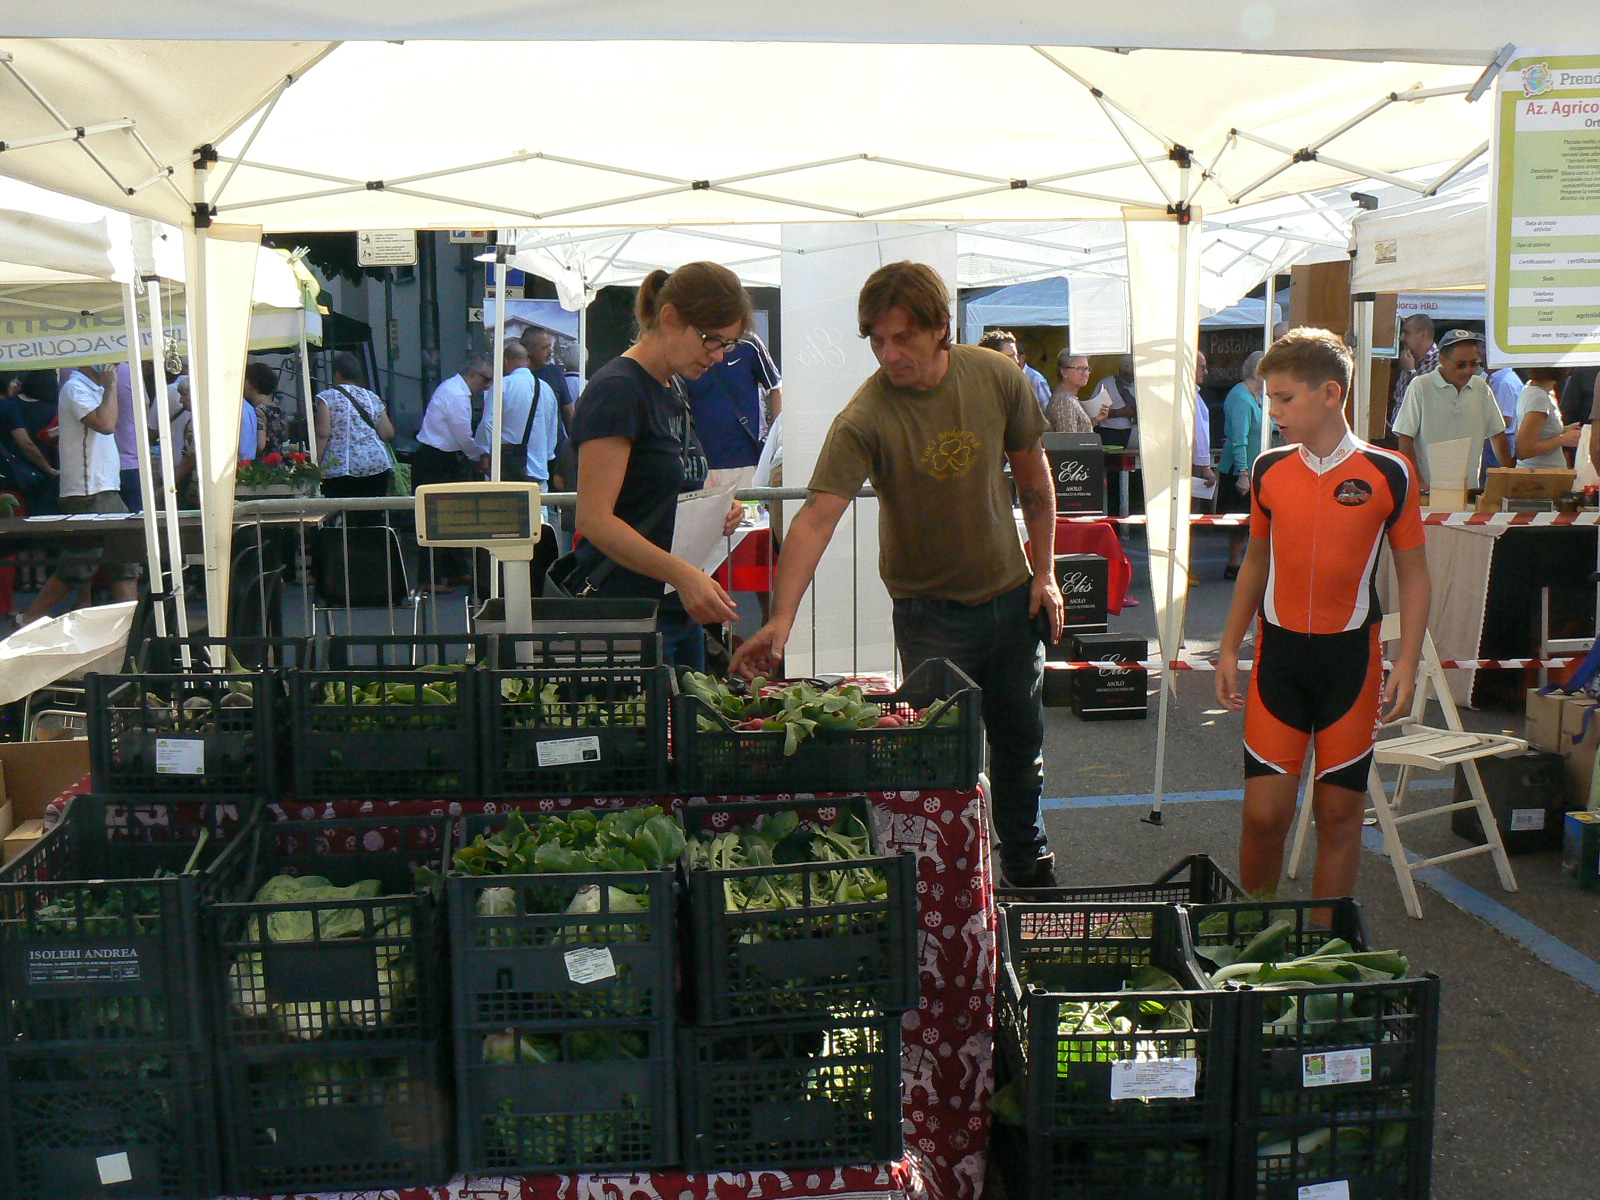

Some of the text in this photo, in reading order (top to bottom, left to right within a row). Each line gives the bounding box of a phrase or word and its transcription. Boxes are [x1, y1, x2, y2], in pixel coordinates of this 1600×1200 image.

[1526, 101, 1599, 117] Az. Agrico
[1397, 301, 1438, 311] lorca HRD
[1058, 460, 1090, 483] Elis
[1061, 571, 1094, 595] Elis
[29, 948, 138, 960] ISOLERI ANDREA
